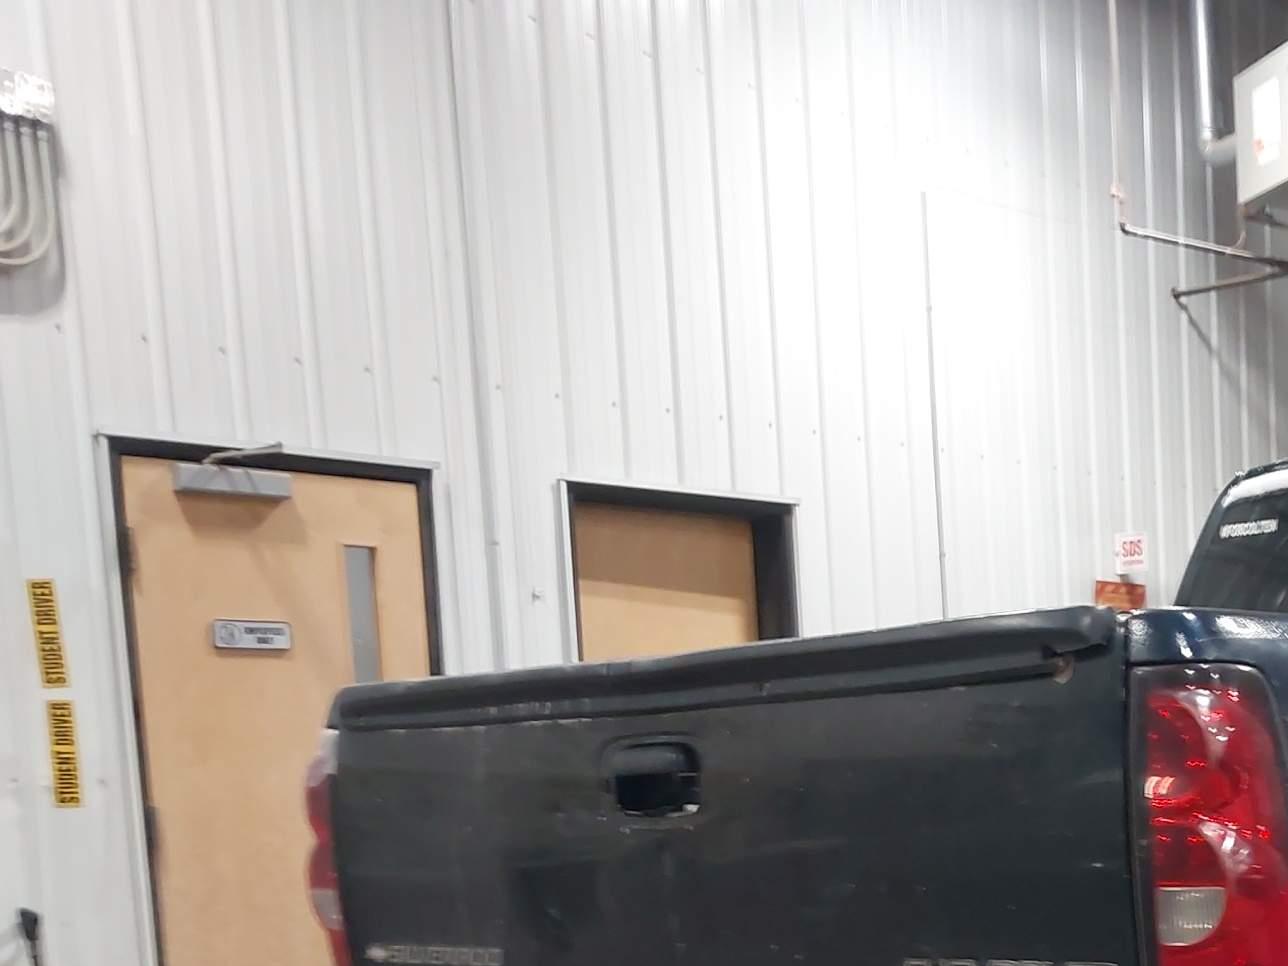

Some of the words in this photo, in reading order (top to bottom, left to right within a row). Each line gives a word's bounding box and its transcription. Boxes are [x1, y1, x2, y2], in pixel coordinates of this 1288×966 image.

[1121, 539, 1144, 558] SDS
[31, 580, 57, 626] DRIVER
[37, 629, 67, 685] STUDENT
[51, 702, 76, 746] DRIVER
[55, 750, 81, 805] STUDENT
